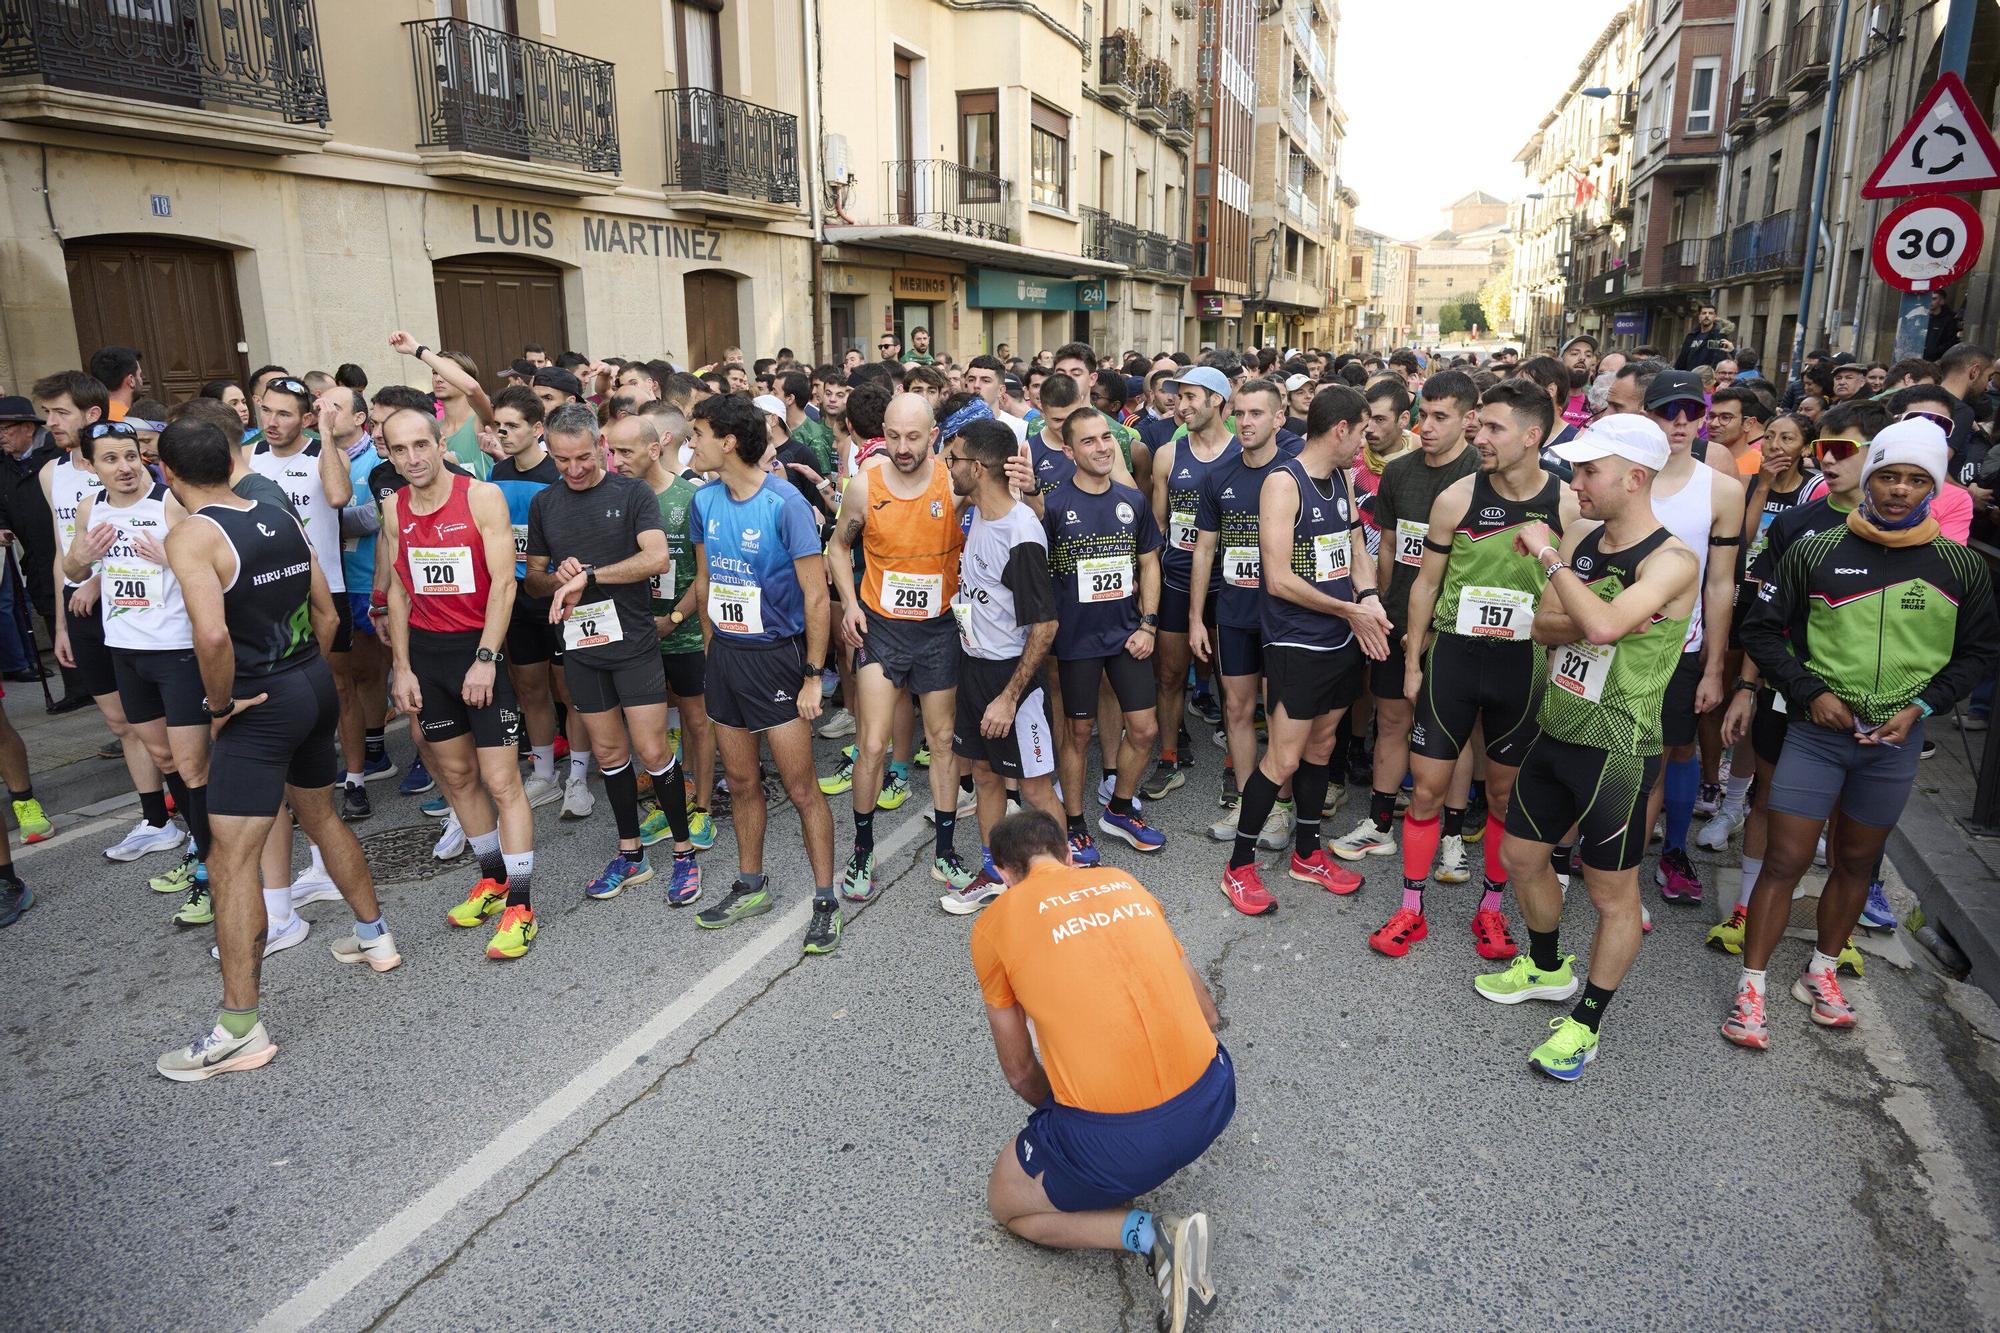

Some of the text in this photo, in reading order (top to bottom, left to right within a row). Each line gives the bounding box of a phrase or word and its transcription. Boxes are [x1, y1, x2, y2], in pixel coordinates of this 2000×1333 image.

[154, 197, 169, 215] 18
[472, 204, 722, 262] LUIS MARTINEZ
[1897, 227, 1955, 260] 30
[1329, 549, 1346, 569] 119
[423, 565, 455, 583] 120
[1235, 562, 1260, 578] 443
[114, 580, 146, 598] 240
[1092, 572, 1123, 592] 323
[895, 589, 928, 608] 293
[1092, 591, 1124, 600] navarban
[720, 602, 744, 622] 118
[894, 608, 928, 616] navarban
[1480, 605, 1513, 627] 157
[580, 620, 599, 637] 12
[1473, 627, 1513, 636] navarban
[1560, 651, 1589, 683] 321
[1038, 881, 1133, 914] ATLETISMO
[1052, 903, 1155, 944] MENDAVIA
